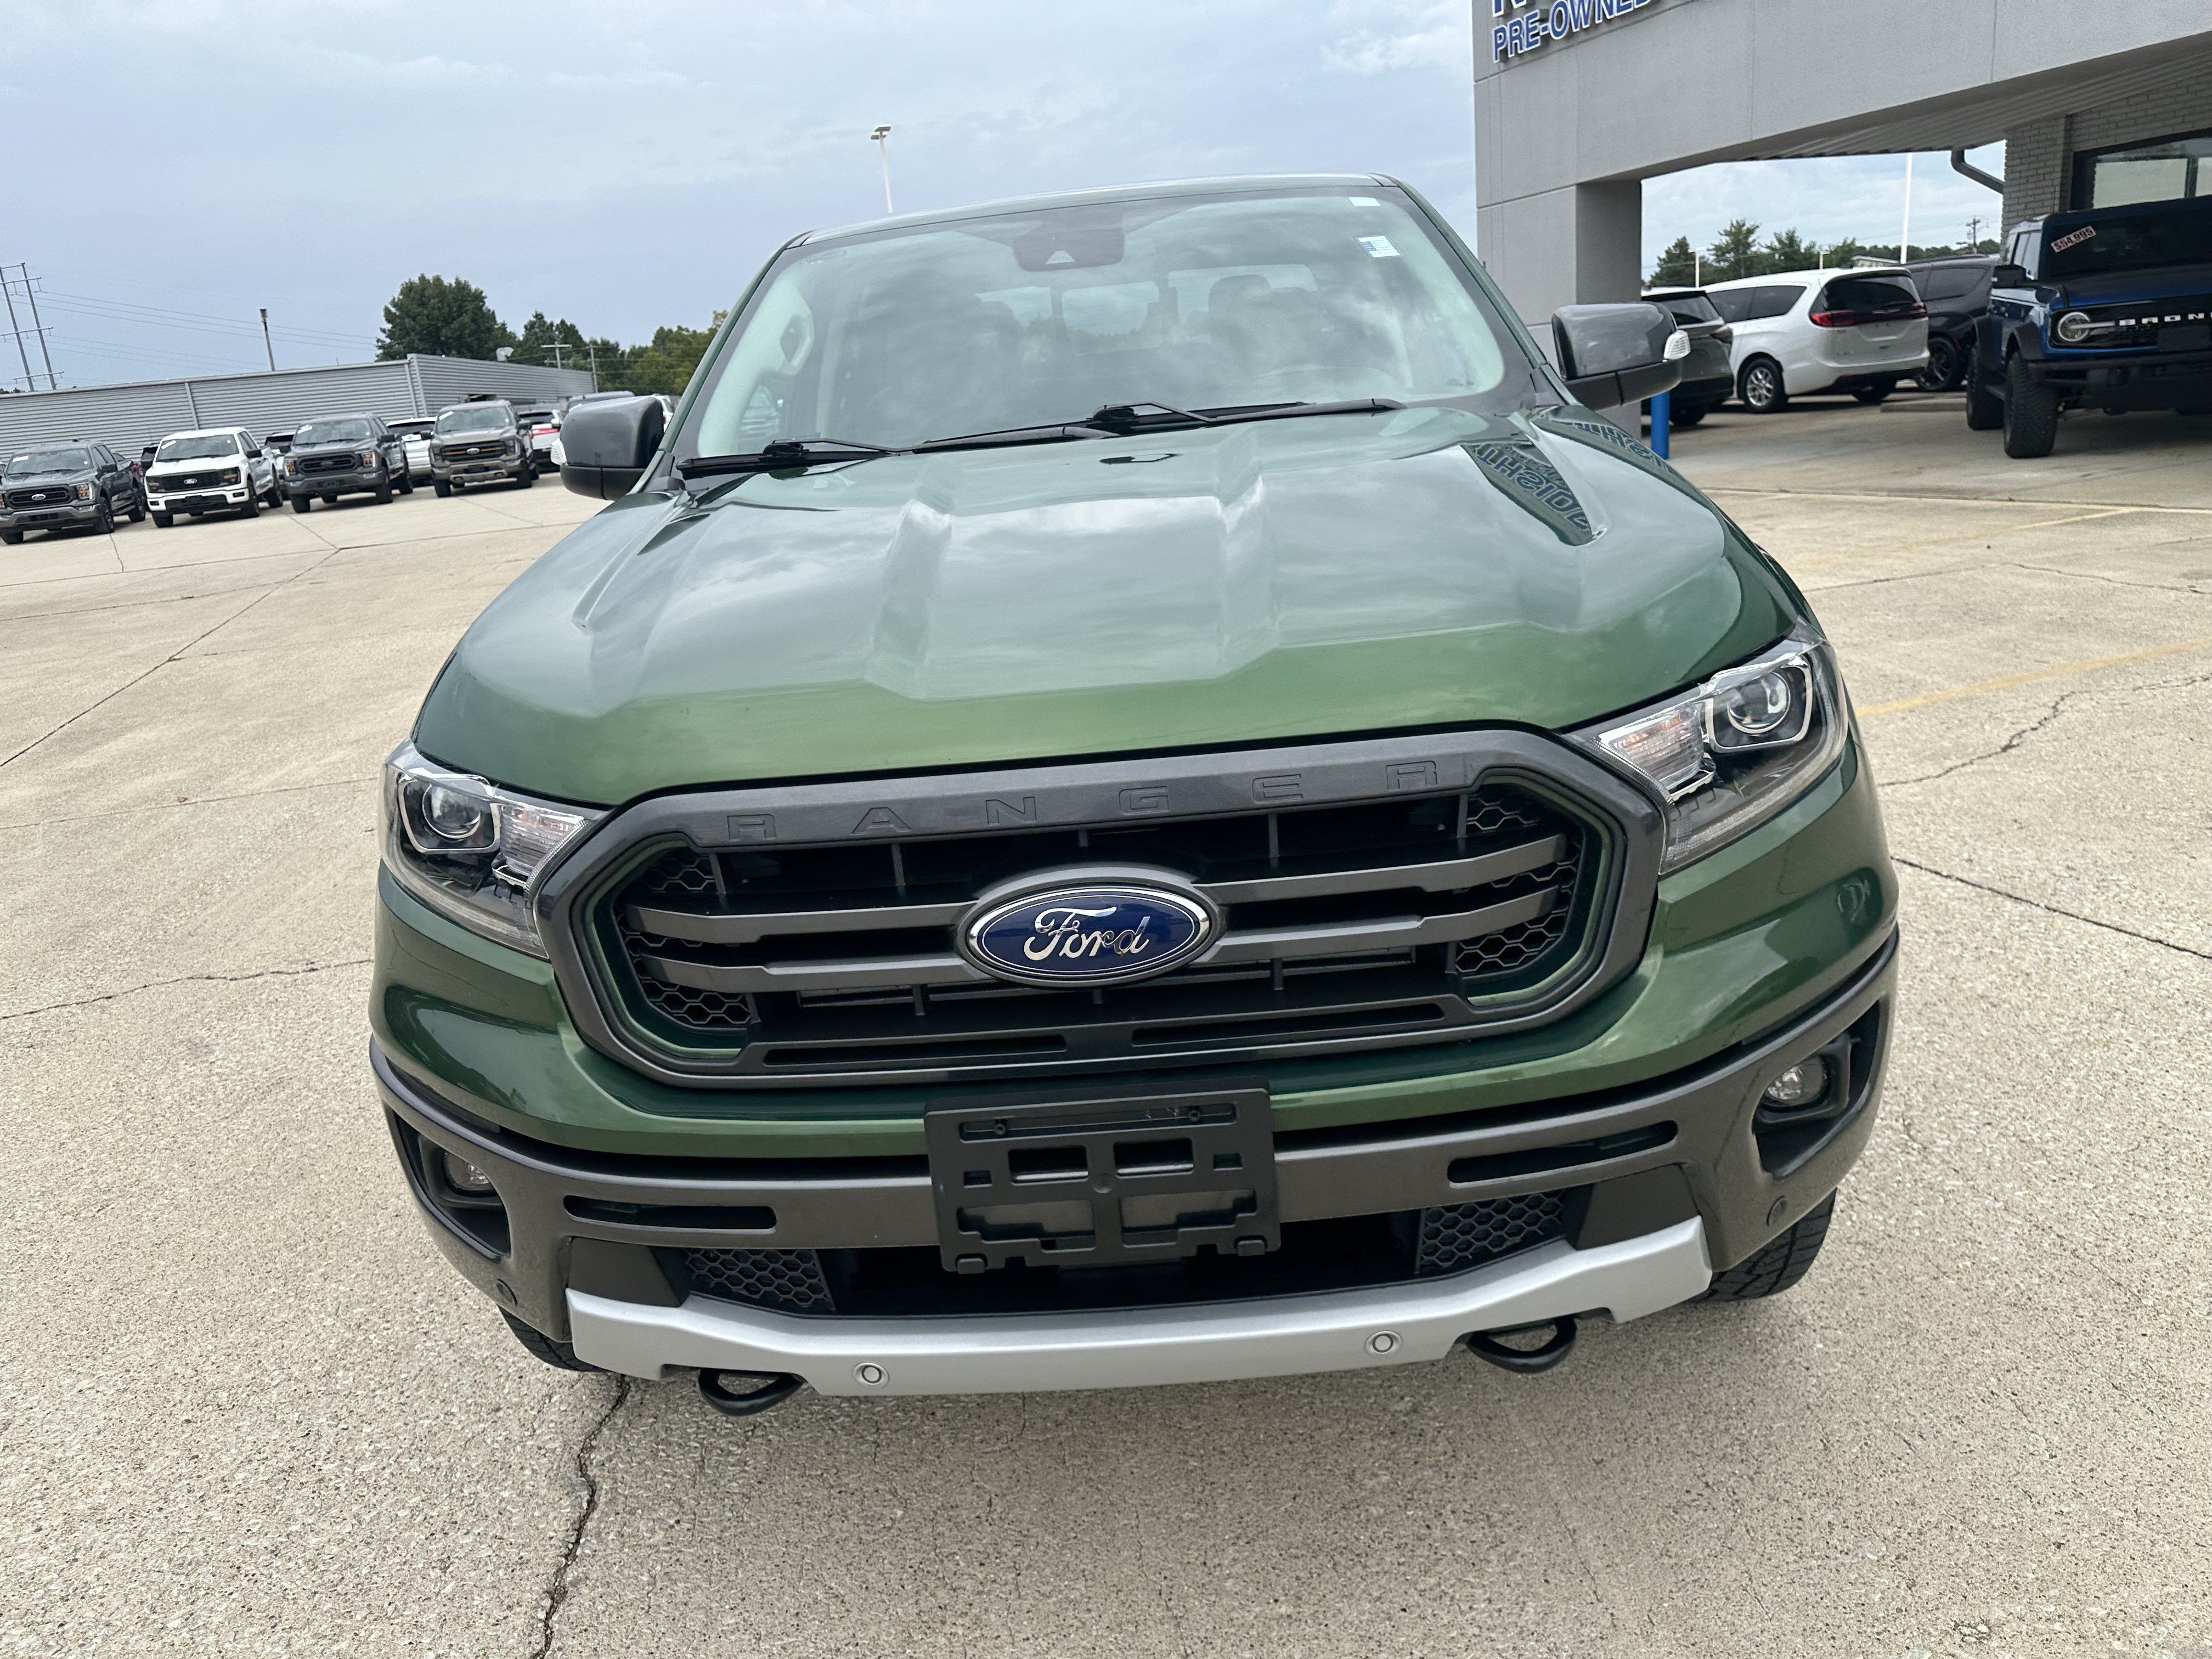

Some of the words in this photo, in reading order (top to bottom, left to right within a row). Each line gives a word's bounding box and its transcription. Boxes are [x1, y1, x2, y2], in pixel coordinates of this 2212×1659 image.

[2119, 312, 2212, 326] BRON
[727, 760, 1438, 841] RANGER
[1024, 906, 1149, 961] Ford
